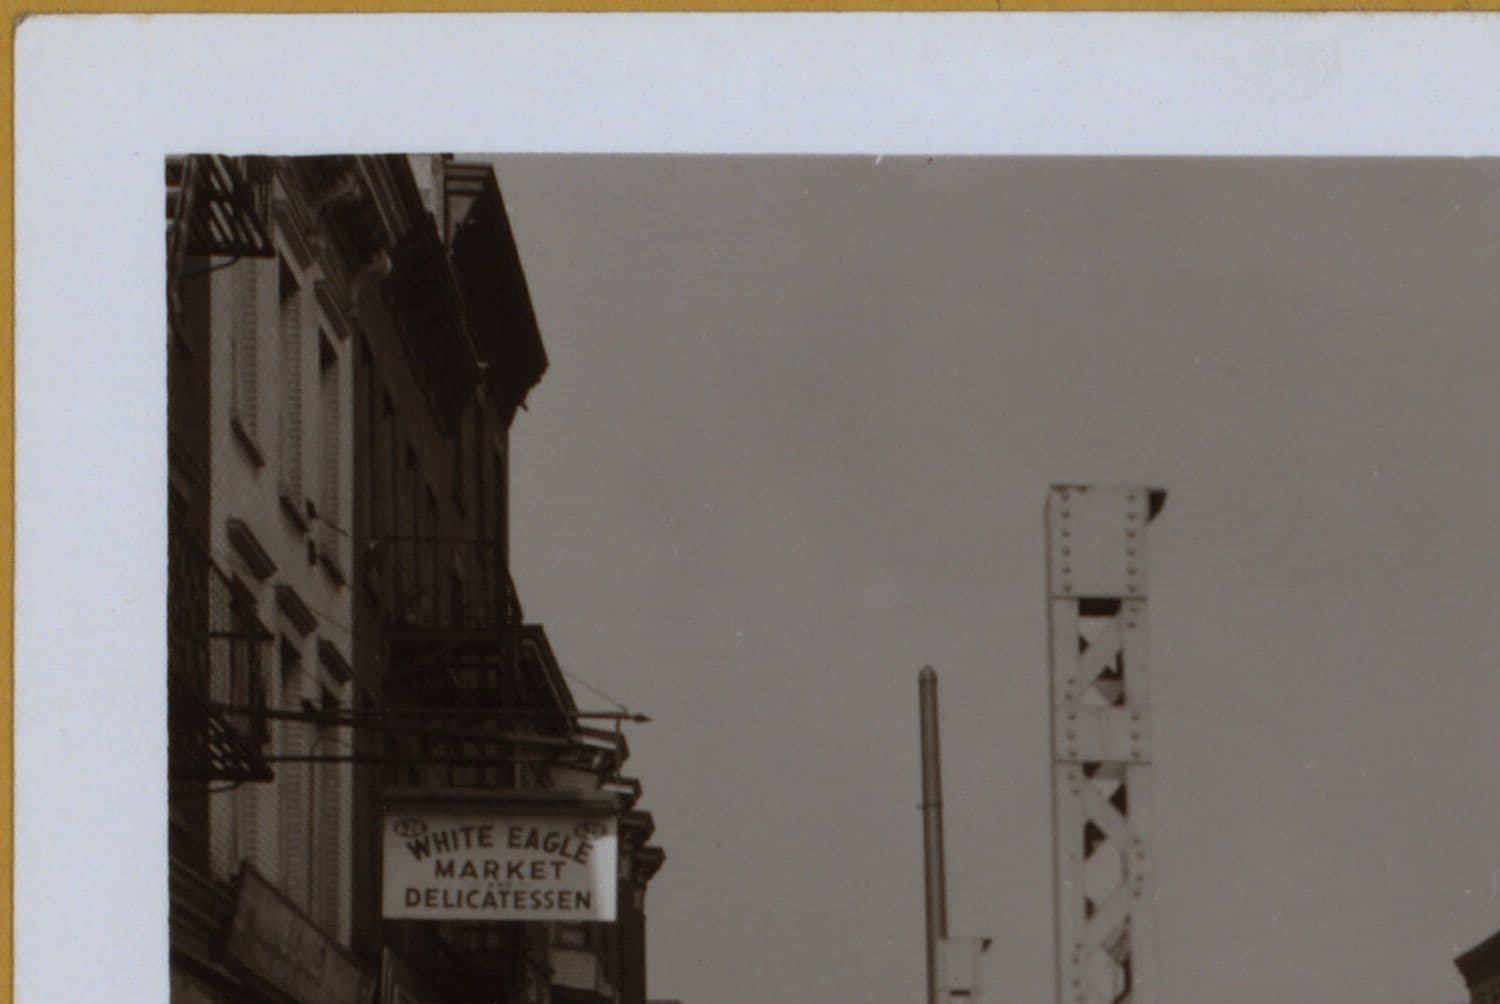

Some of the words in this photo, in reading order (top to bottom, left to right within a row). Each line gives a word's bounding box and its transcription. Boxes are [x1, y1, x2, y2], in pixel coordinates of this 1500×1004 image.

[406, 824, 494, 861] WHITE
[508, 825, 594, 866] EAGLE
[435, 859, 567, 881] MARKET
[405, 886, 593, 911] DELICATESSEN
